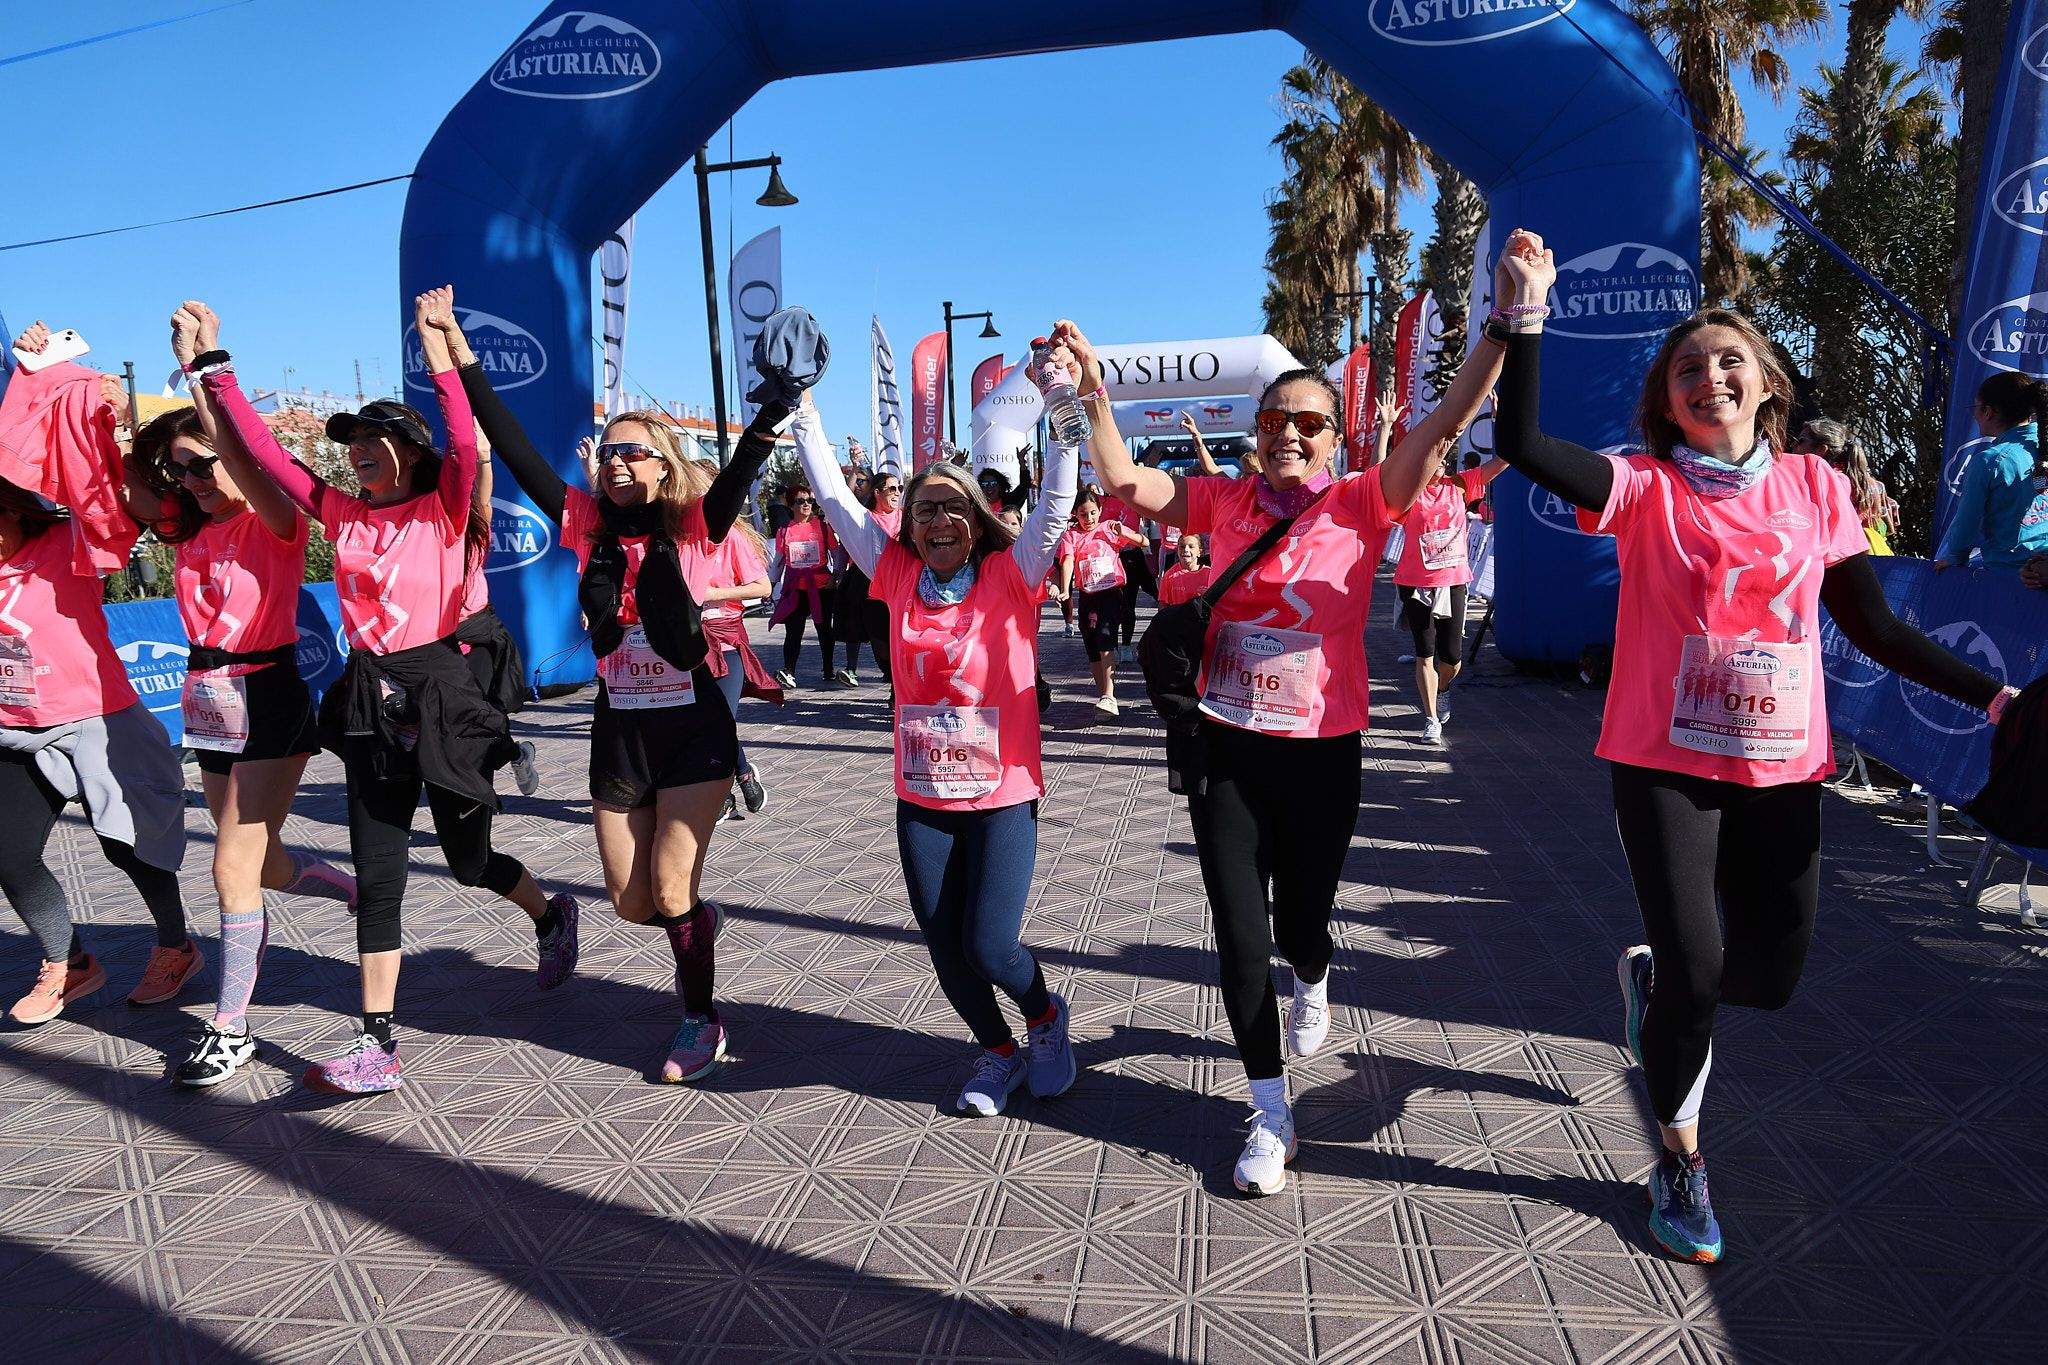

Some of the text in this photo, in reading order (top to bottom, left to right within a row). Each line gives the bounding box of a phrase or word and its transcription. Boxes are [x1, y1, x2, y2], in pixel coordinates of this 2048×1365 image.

[1385, 0, 1566, 30] ASTURI
[524, 38, 639, 54] CENTRAL LECHERA
[498, 52, 648, 82] ASTURIANA
[1570, 276, 1636, 290] CENTRAL
[1547, 288, 1693, 321] ASTURIANA
[2014, 317, 2048, 328] CENT
[405, 342, 535, 375] ASANA
[1404, 318, 1421, 409] Santander
[1098, 352, 1220, 385] YSHO
[923, 356, 937, 435] Santander
[993, 395, 1035, 405] OYSHO
[1167, 444, 1229, 453] VOVO
[975, 453, 1014, 464] OYSHO
[1242, 640, 1282, 653] ASTURIANA
[0, 664, 14, 677] 16
[127, 660, 189, 675] NTRAL LECHE
[630, 662, 665, 676] 016
[1727, 656, 1778, 671] ASTURIANA
[128, 670, 189, 695] TURIA
[1240, 670, 1280, 691] 016
[1723, 692, 1777, 715] 016
[200, 710, 225, 723] 016
[1211, 705, 1243, 719] OYSHO
[1263, 716, 1296, 727] Santander
[1689, 721, 1718, 732] CARRERA
[1740, 729, 1762, 737] MUJER
[1731, 717, 1757, 727] 5999
[1684, 733, 1728, 749] OYSHO
[1756, 744, 1794, 753] Santander
[929, 748, 968, 763] 016
